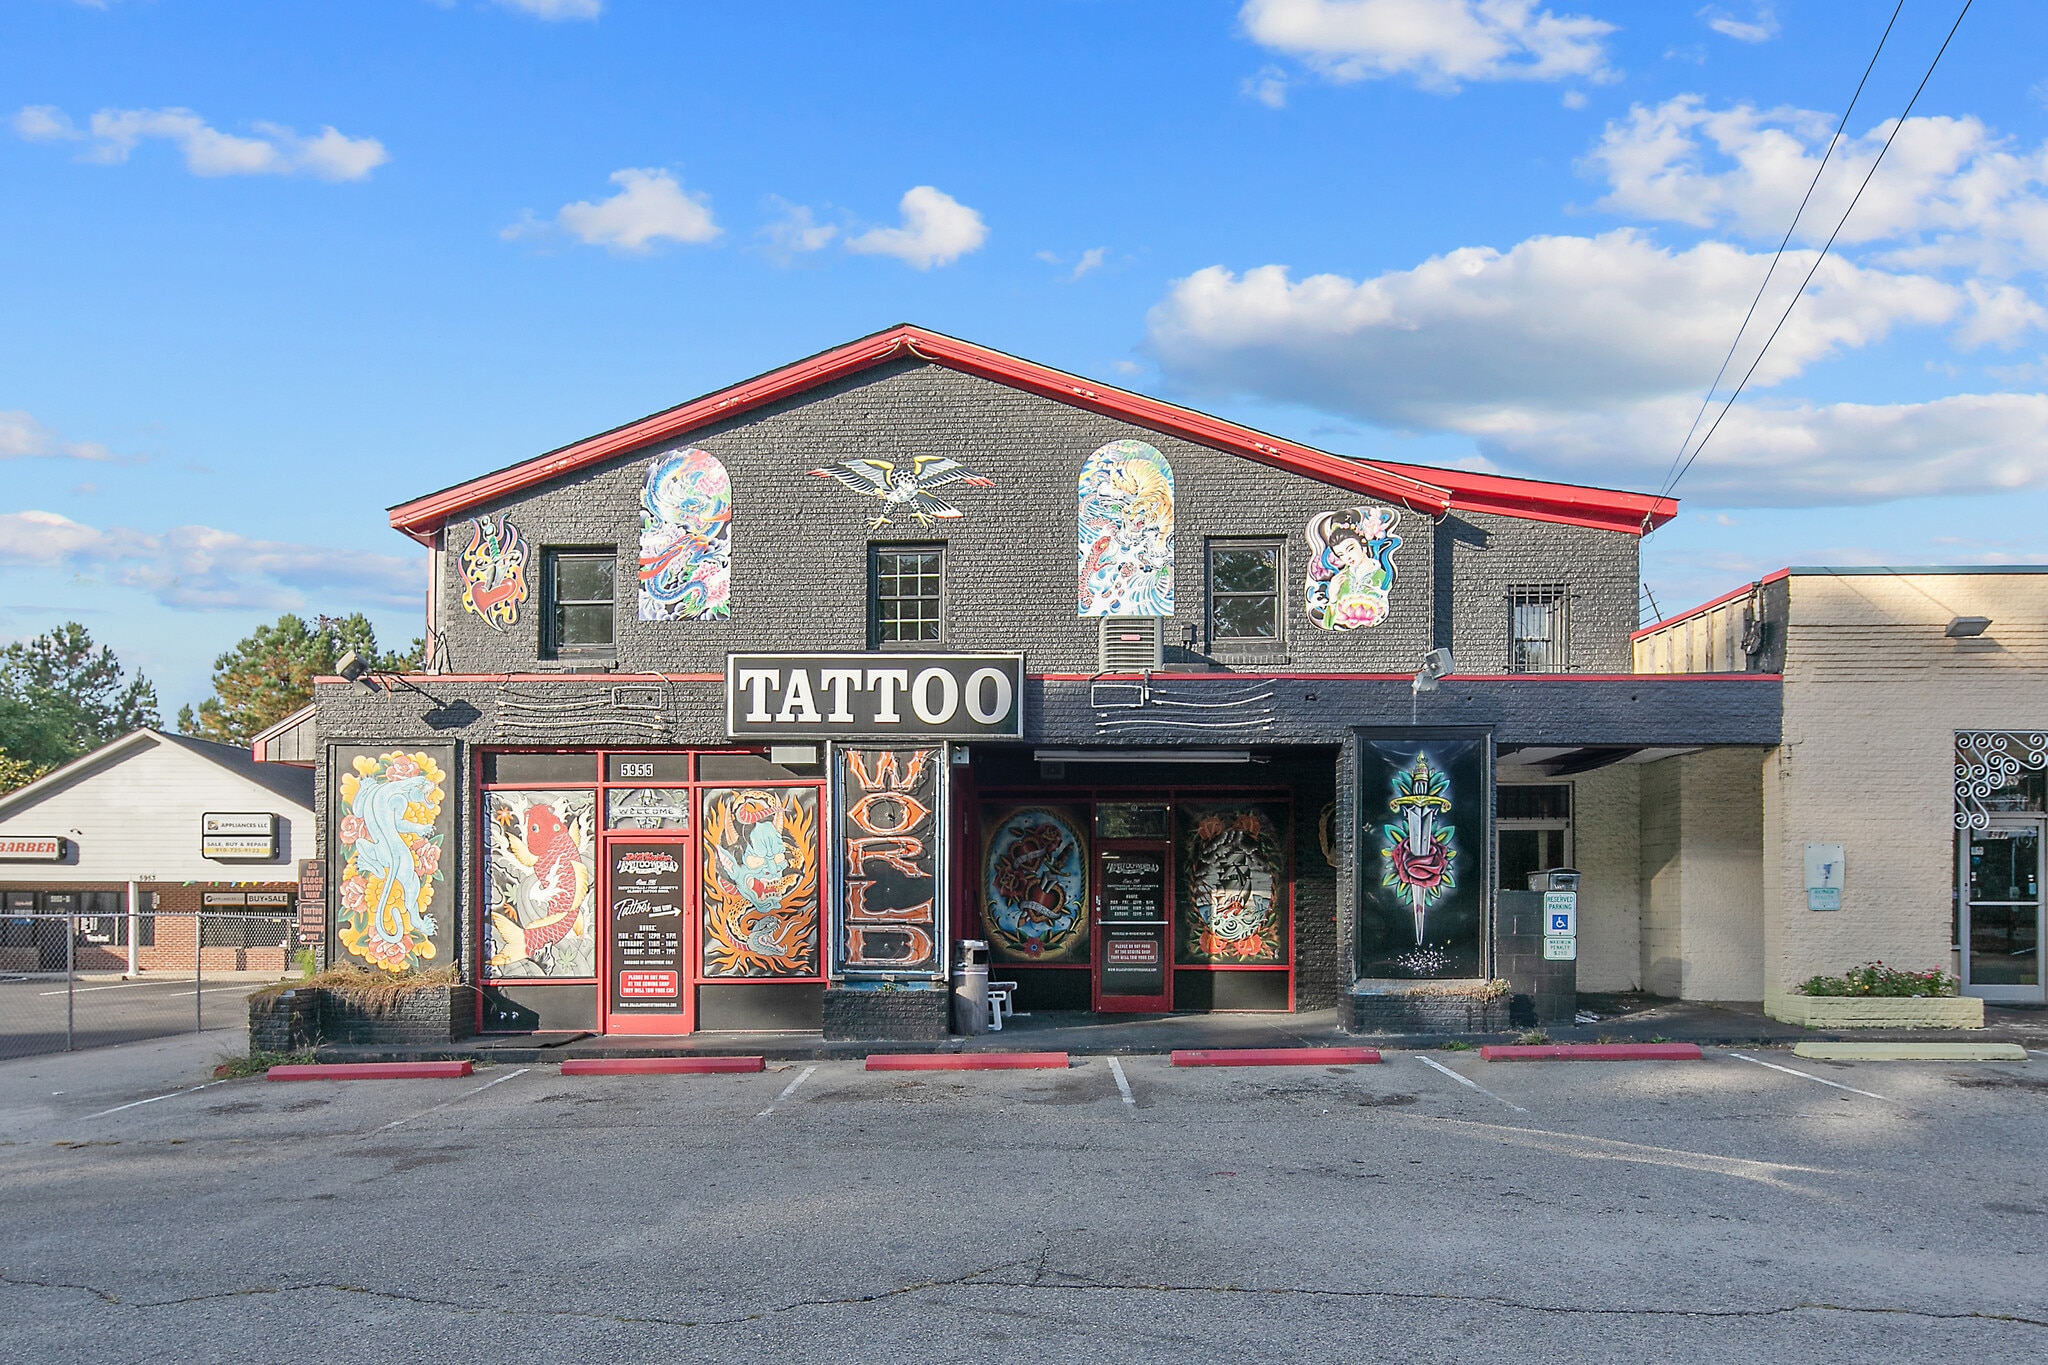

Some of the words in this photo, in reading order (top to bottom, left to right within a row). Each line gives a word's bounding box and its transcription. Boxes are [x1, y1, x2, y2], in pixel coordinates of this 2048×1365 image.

[739, 667, 1013, 725] TATTOO
[622, 764, 652, 776] 5955
[618, 807, 674, 815] WELCOME
[0, 842, 56, 853] BARBER
[845, 750, 934, 966] WORLD
[613, 898, 652, 920] Tattoos
